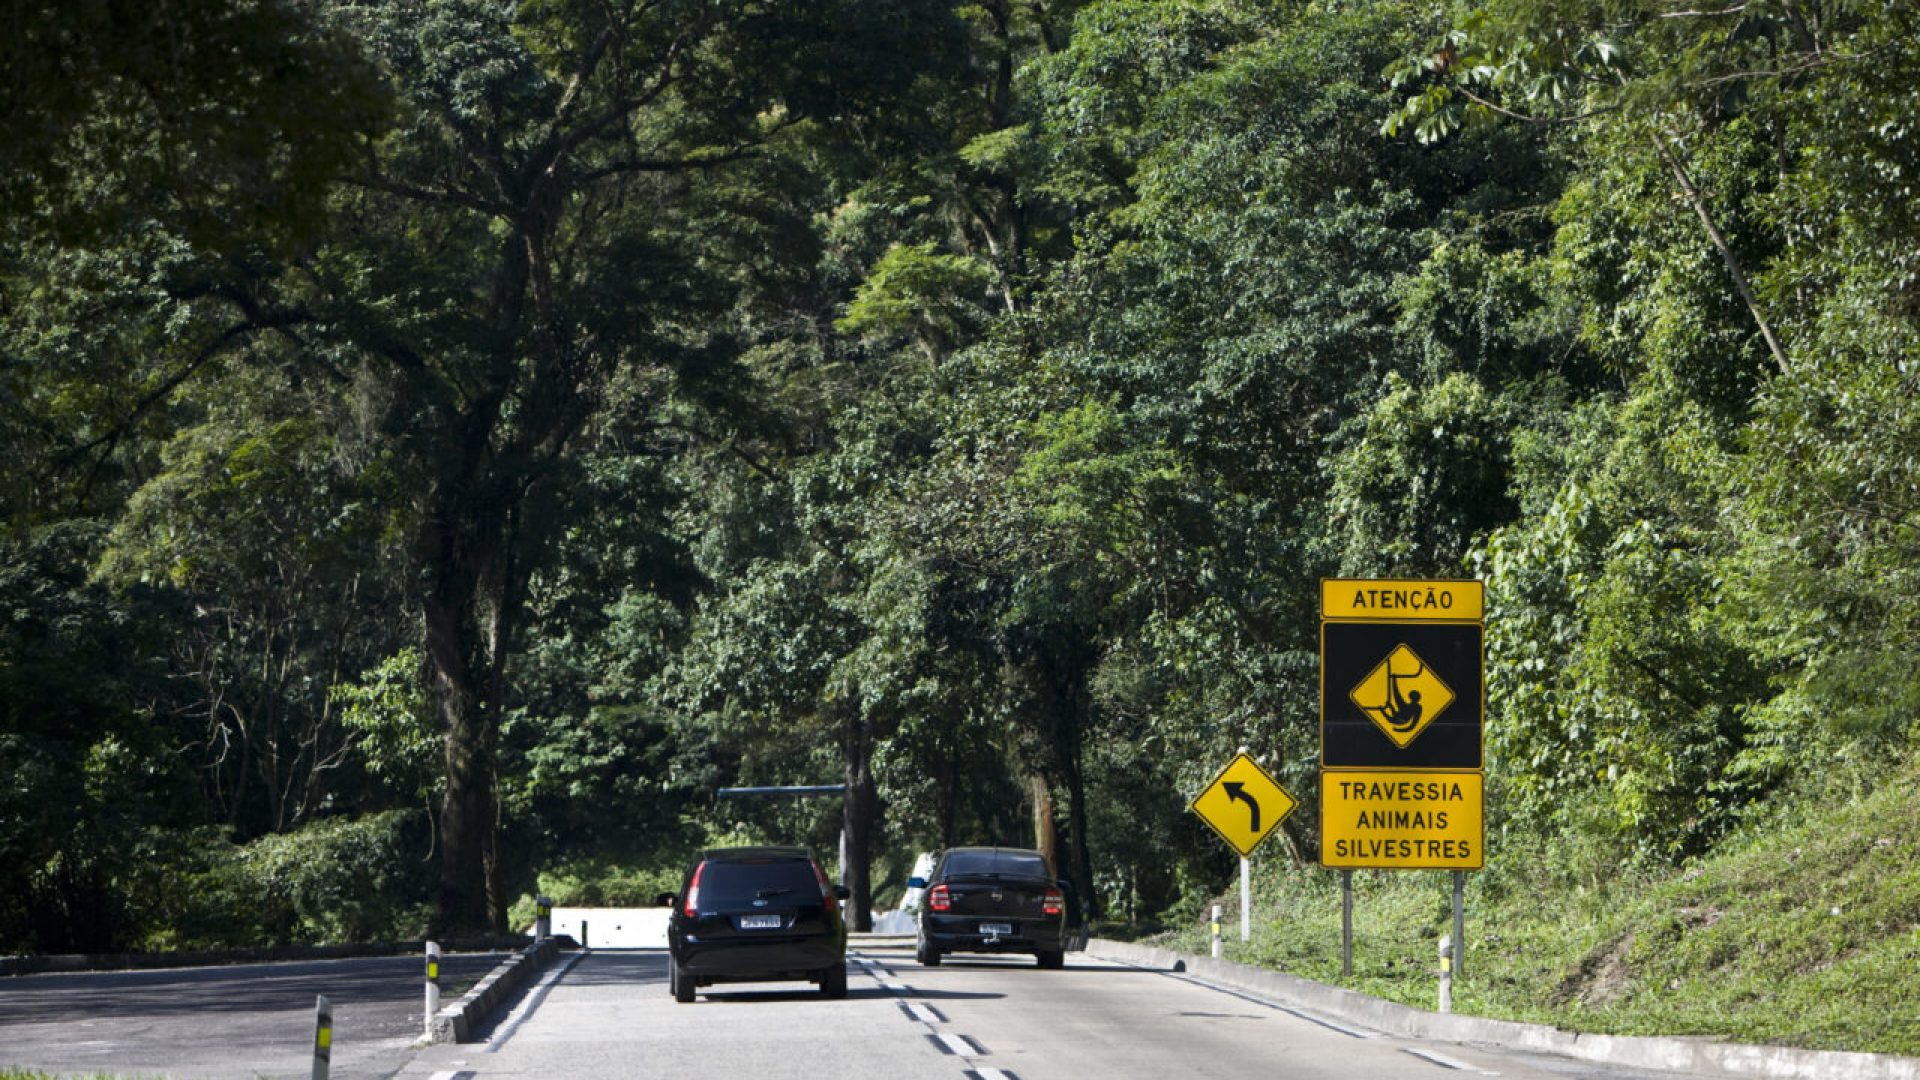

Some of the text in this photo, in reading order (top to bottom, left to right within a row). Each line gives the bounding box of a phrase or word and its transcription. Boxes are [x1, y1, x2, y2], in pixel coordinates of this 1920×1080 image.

[1352, 587, 1453, 610] ATENÇÃO
[1340, 782, 1463, 801] TRAVESSIA
[1356, 811, 1448, 829] ANIMAIS
[1336, 839, 1470, 859] SILVESTRES
